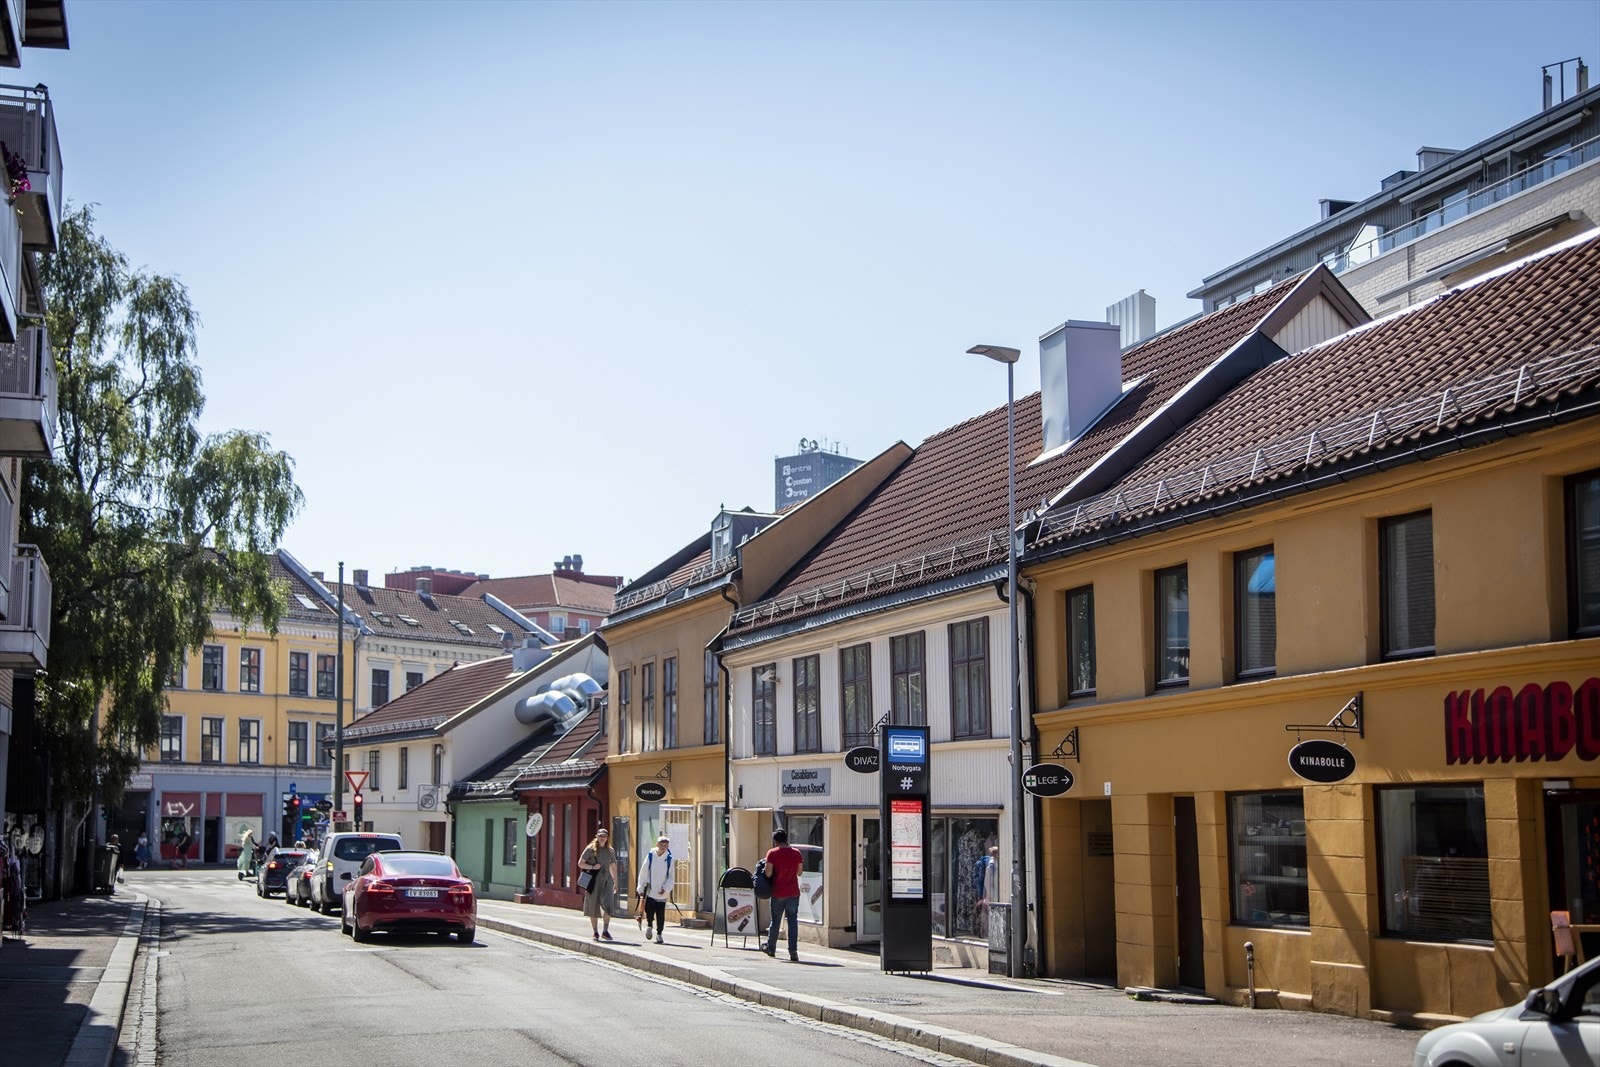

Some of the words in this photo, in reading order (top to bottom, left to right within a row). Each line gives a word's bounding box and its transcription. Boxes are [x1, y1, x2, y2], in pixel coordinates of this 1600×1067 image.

[793, 478, 812, 486] posten
[1300, 755, 1345, 768] KINABOLLE
[892, 764, 921, 773] Norbygata
[791, 770, 818, 780] Casablanca
[1037, 776, 1058, 785] LEGE
[782, 783, 796, 795] Coffee
[423, 797, 433, 806] 30
